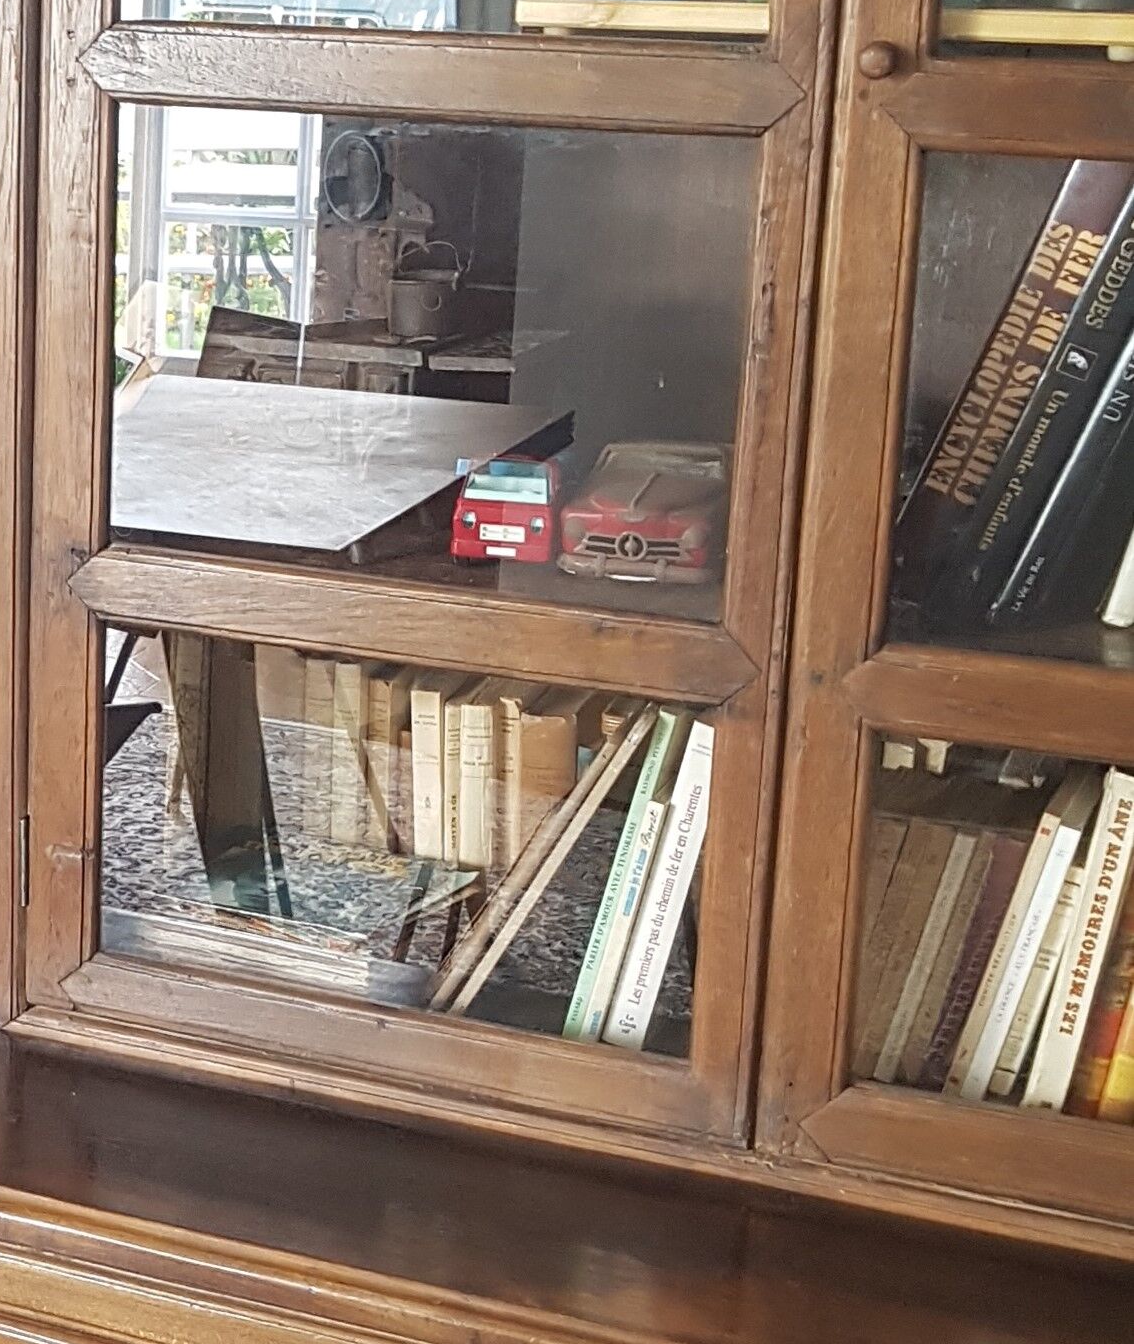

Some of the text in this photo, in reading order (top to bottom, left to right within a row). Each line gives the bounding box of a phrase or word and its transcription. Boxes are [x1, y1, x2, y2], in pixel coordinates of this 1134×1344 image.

[924, 220, 1073, 495] ENCYCLOPEDIE DES
[954, 230, 1107, 505] CHEMINS DE FER
[1086, 237, 1134, 329] GEDDES
[978, 389, 1069, 551] Un monde d'enfants
[1102, 389, 1131, 423] UN
[628, 784, 703, 1006] Les premiers pas du chemin de fer en Charentes
[1058, 797, 1133, 1037] LES MÉMOIRES D'UN ÂNE
